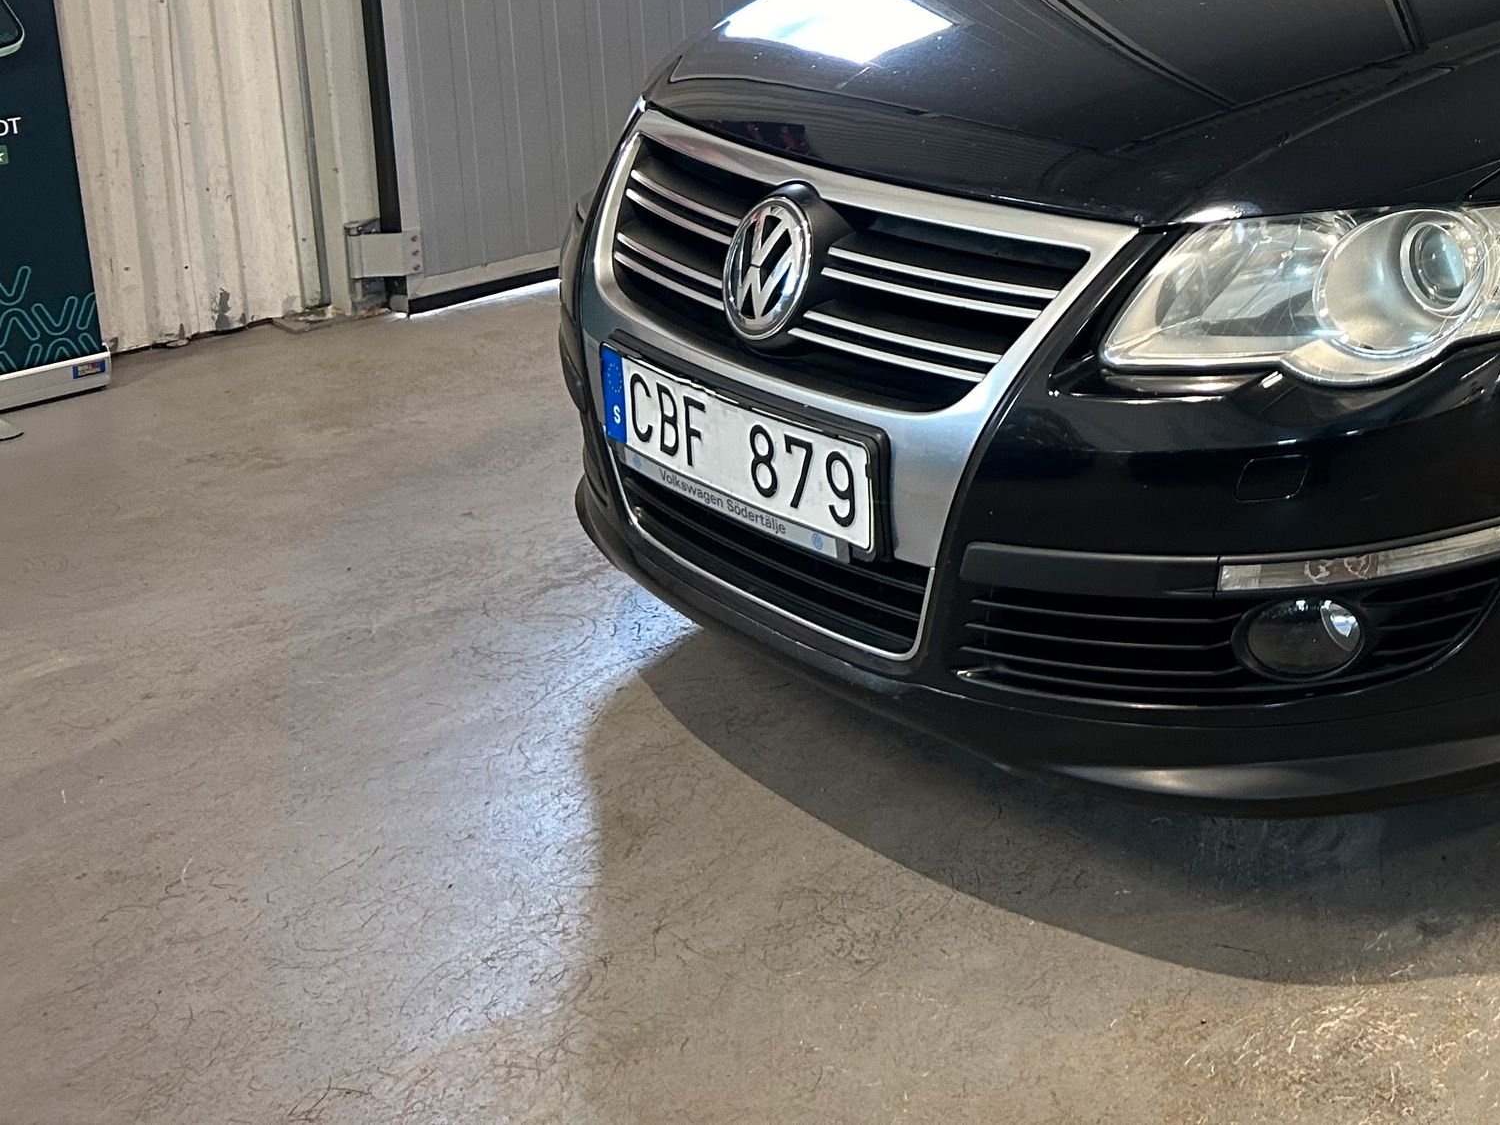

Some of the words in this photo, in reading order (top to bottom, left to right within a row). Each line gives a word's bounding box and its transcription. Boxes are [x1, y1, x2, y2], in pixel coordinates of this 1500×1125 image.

[613, 405, 621, 425] S
[629, 372, 706, 467] CBF
[749, 424, 856, 528] 879
[658, 467, 724, 508] Volkswagen
[727, 496, 786, 535] Södertälje
